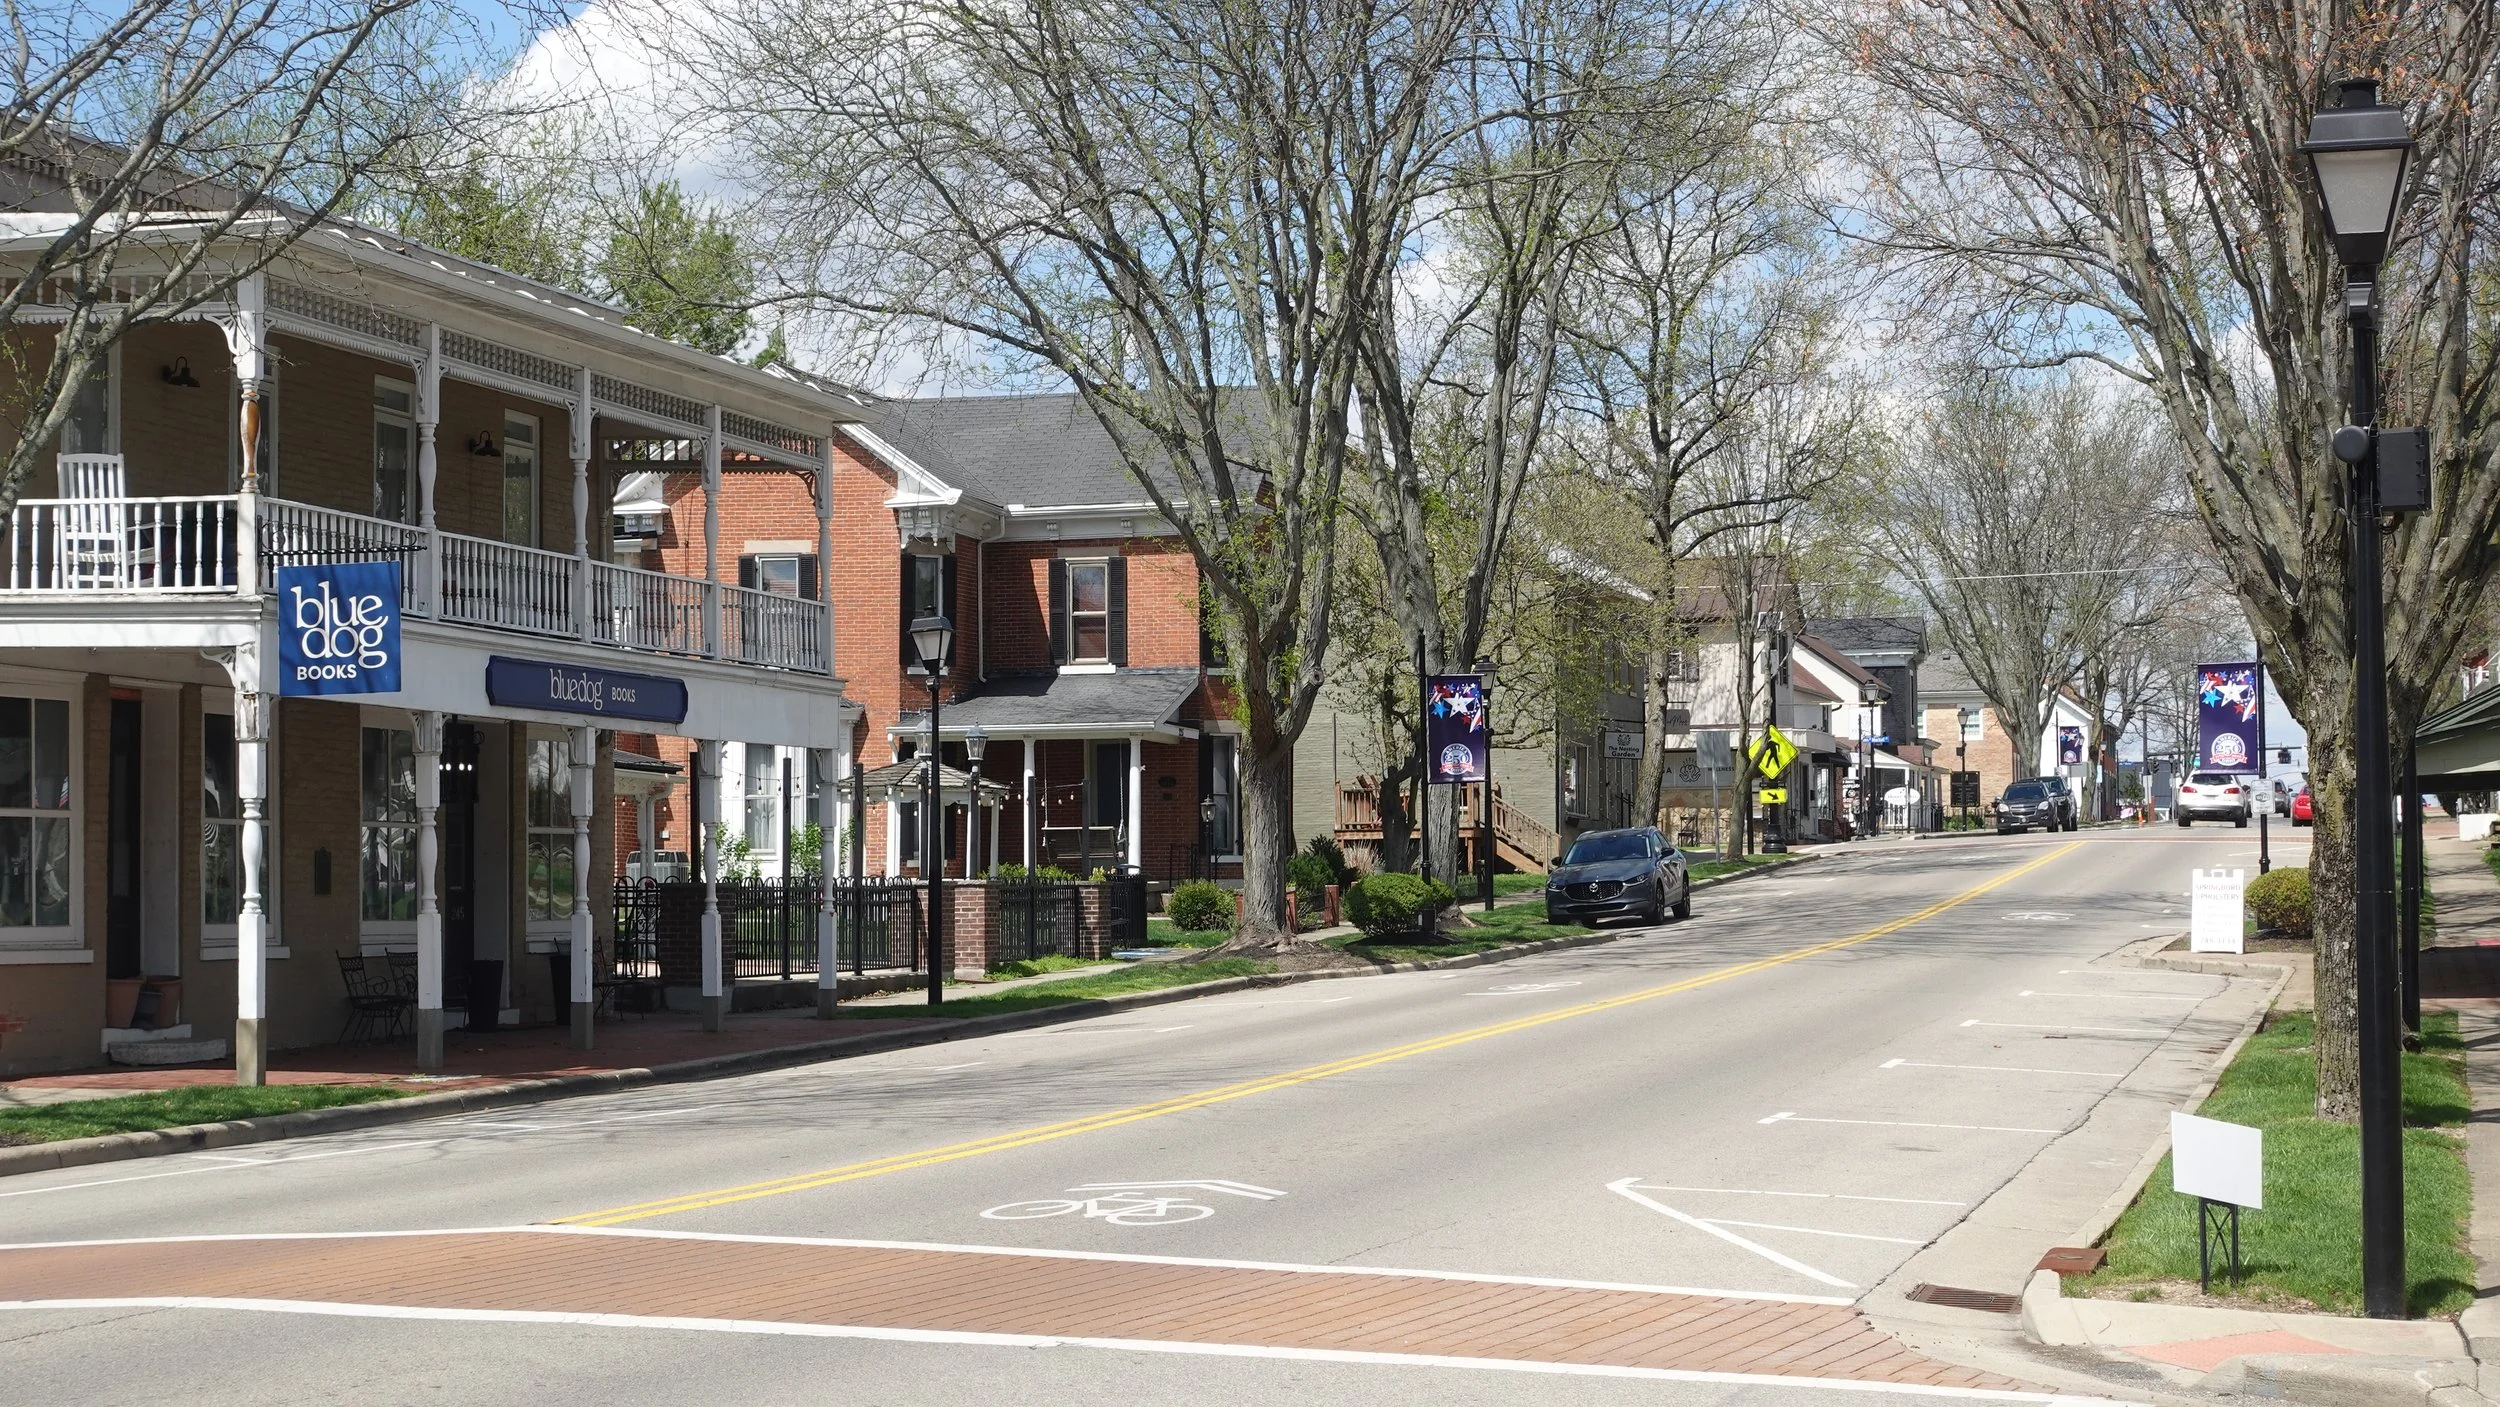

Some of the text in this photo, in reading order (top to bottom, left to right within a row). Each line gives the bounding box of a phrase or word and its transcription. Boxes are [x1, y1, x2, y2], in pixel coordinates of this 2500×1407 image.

[290, 581, 383, 629] blue
[302, 614, 389, 669] dog
[297, 664, 357, 680] BOOKS
[549, 668, 636, 710] bluedog BOOKS
[1444, 754, 1469, 766] 250
[2215, 744, 2242, 756] 250
